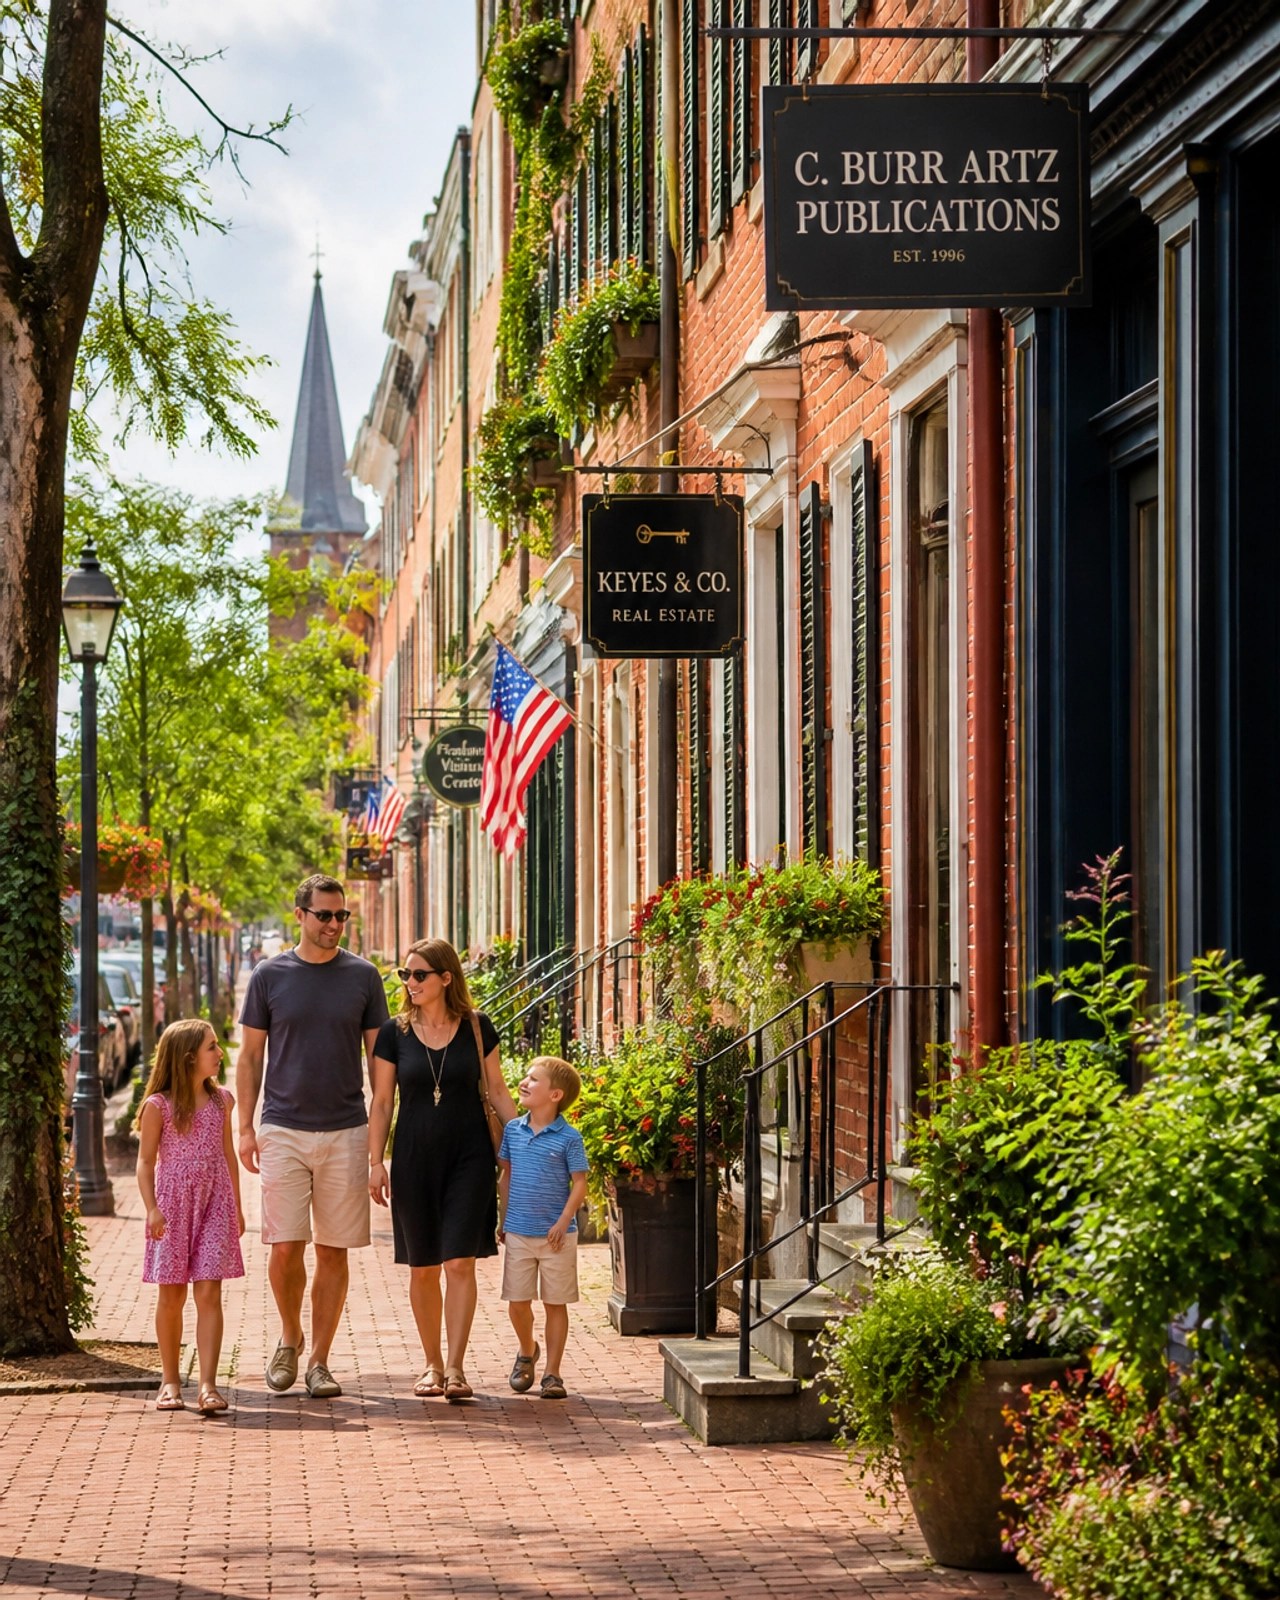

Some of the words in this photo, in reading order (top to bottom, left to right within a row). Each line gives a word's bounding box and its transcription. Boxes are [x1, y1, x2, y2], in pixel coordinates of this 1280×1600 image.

[794, 151, 829, 186] C.
[841, 150, 948, 185] BURR
[958, 149, 1060, 184] ARTZ
[796, 197, 1061, 234] PUBLICATIONS
[893, 249, 926, 263] EST.
[931, 249, 966, 262] 1996
[597, 571, 667, 593] KEYES
[673, 571, 692, 593] &
[696, 571, 731, 593] CO.
[612, 609, 653, 622] REAL
[659, 608, 715, 622] ESTATE
